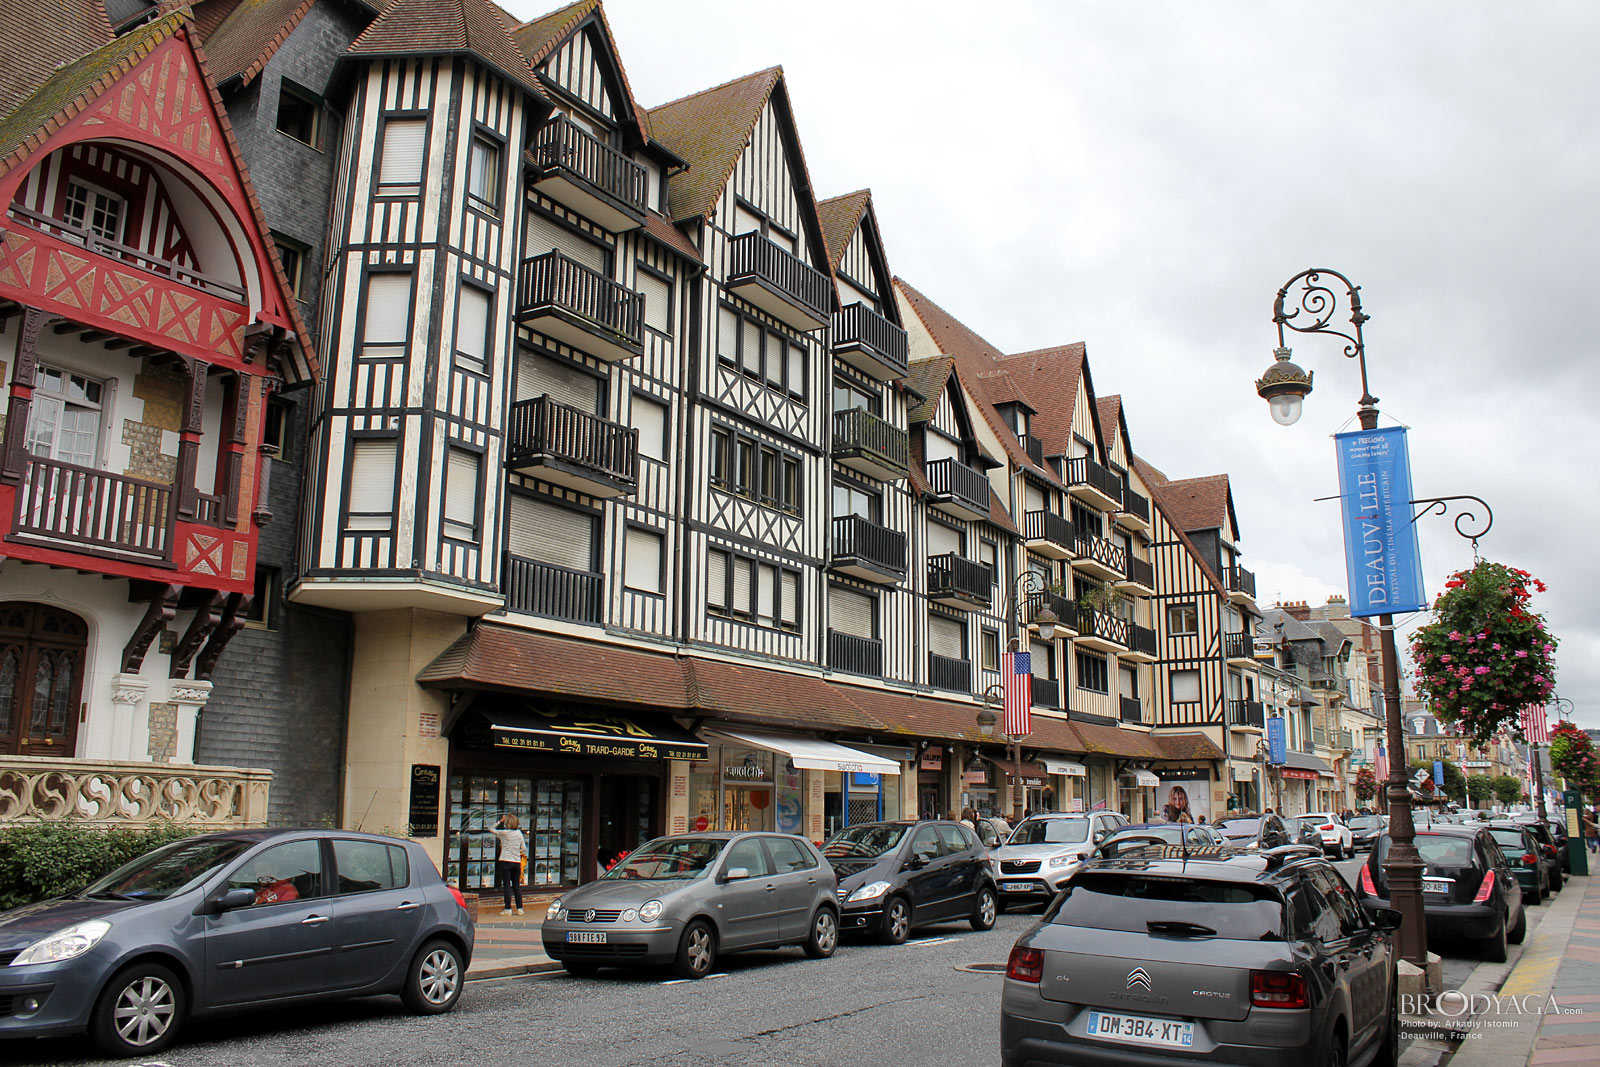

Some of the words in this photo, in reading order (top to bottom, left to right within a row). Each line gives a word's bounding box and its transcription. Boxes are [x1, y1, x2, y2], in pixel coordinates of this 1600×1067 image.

[1381, 470, 1392, 517] AMÉRICAIN
[1386, 519, 1394, 552] CINÉMA
[1389, 553, 1396, 565] DU
[1391, 566, 1400, 604] FESTIVAL
[726, 765, 758, 777] swatch
[1192, 990, 1231, 998] CACTUS
[1100, 1015, 1182, 1041] DM-384-XT
[1183, 1035, 1191, 1045] 14
